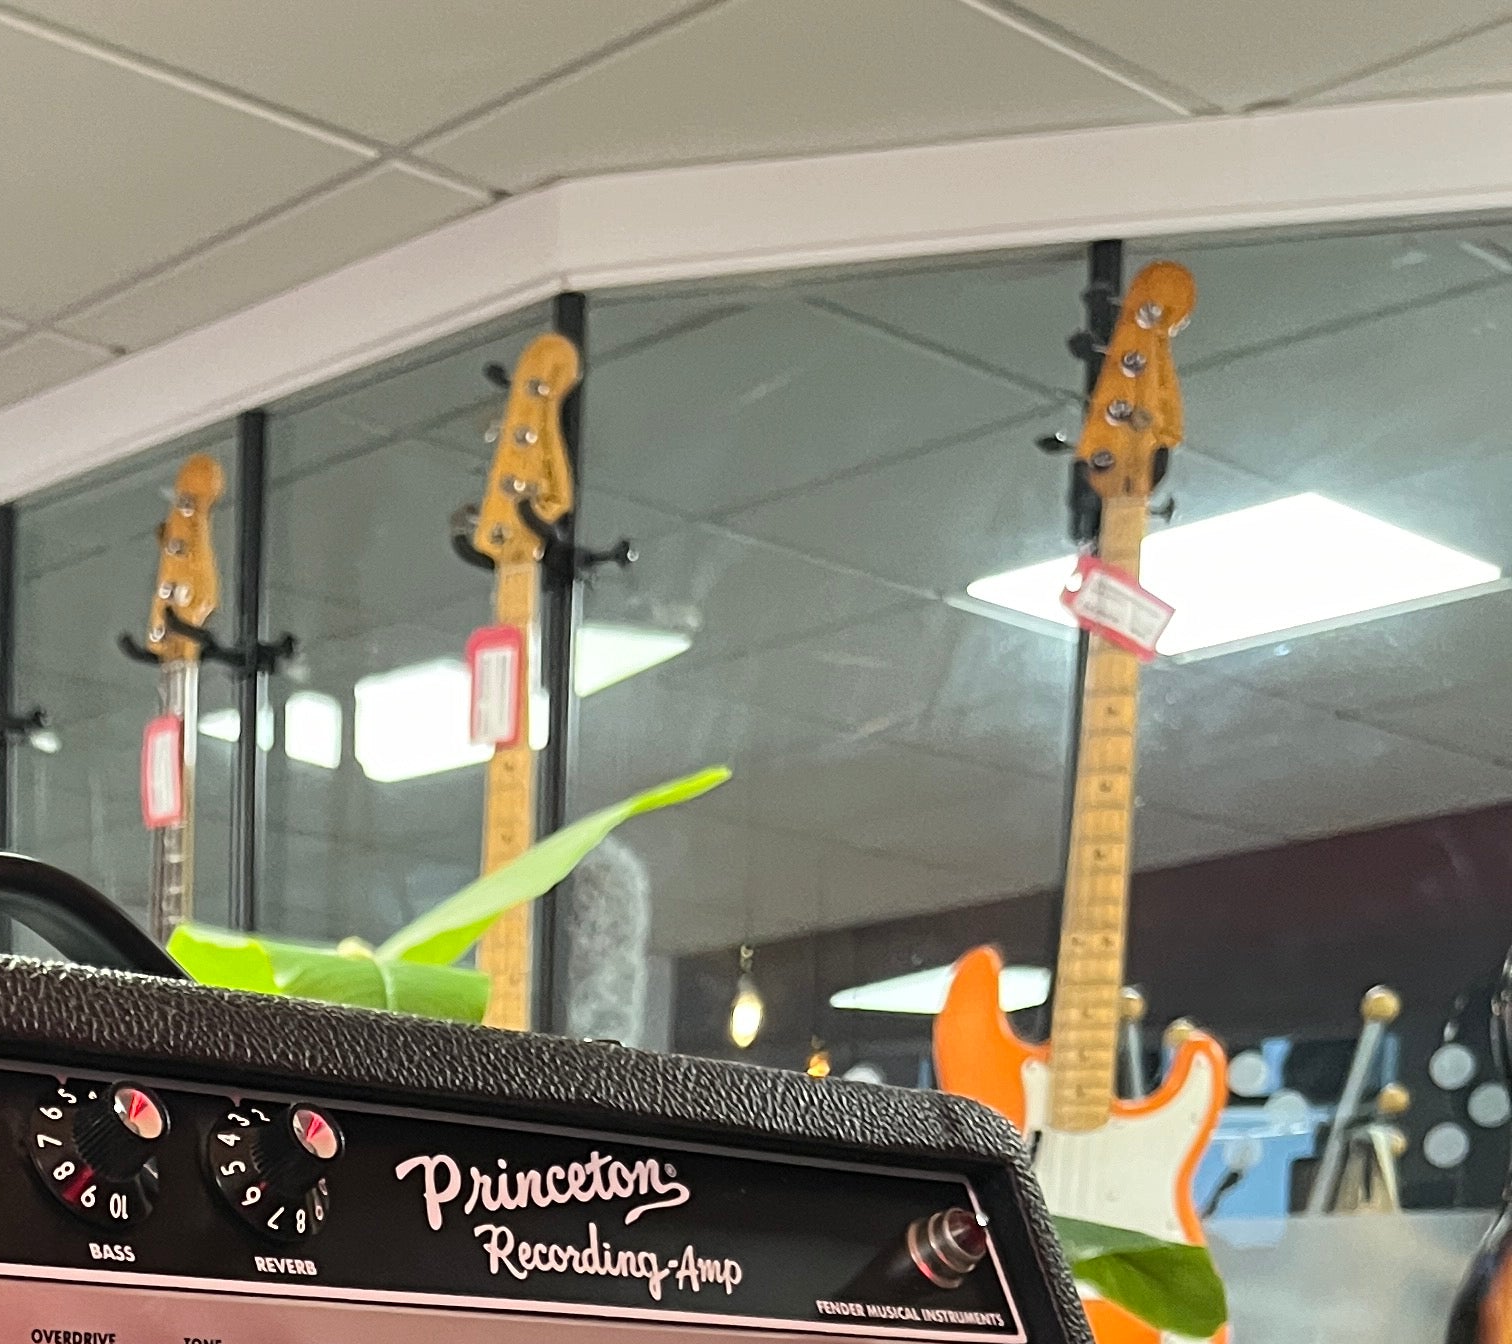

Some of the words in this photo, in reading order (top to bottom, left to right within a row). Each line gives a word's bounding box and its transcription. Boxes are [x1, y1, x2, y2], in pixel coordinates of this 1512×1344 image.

[217, 1133, 241, 1147] 4
[37, 1134, 63, 1148] 7
[53, 1161, 75, 1181] 8
[220, 1160, 246, 1176] 5
[395, 1150, 691, 1231] Princeton
[267, 1206, 285, 1230] 7
[295, 1208, 306, 1234] 8
[88, 1243, 136, 1262] BASS
[473, 1222, 743, 1301] Recording-Amp
[254, 1256, 318, 1276] REVERB
[816, 1300, 866, 1317] FENDER
[865, 1304, 921, 1321] MUSICAL
[920, 1308, 1005, 1327] INSTRUMENTS
